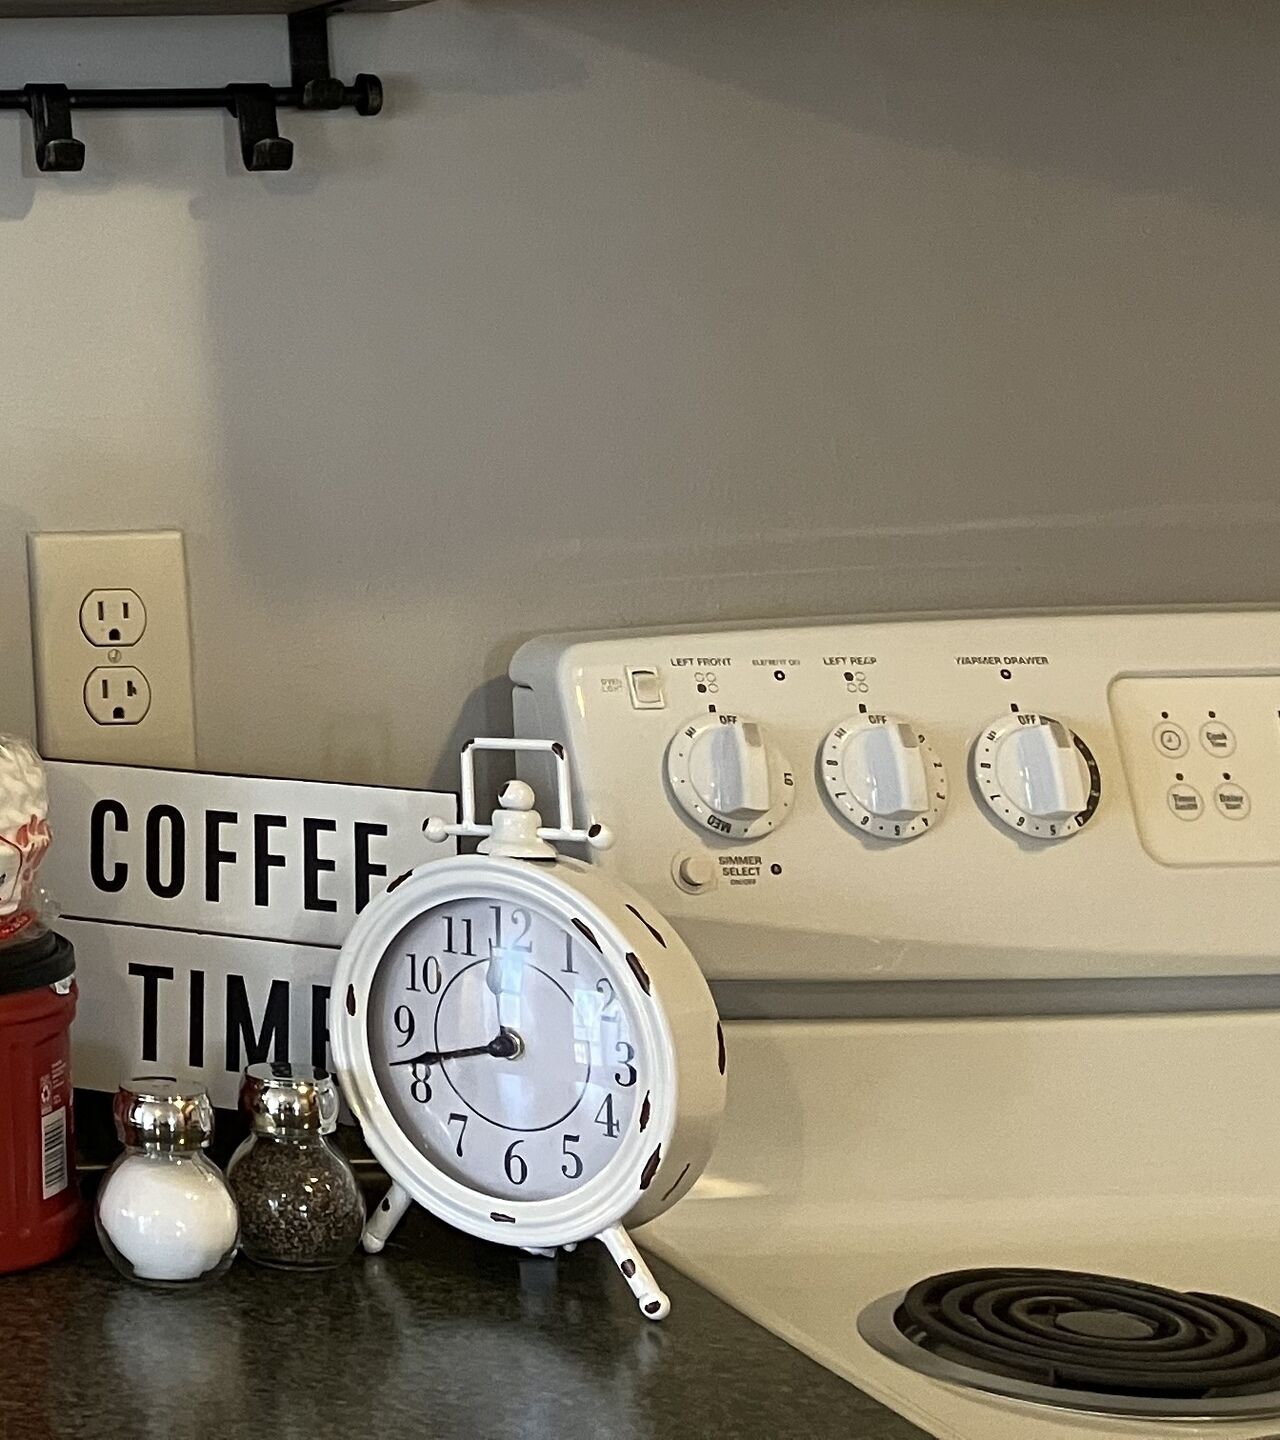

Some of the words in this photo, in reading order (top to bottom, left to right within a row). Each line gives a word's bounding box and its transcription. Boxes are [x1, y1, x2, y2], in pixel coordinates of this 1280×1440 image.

[670, 657, 694, 667] LEFT
[696, 657, 732, 667] FRONT
[823, 656, 848, 667] LEFT
[954, 655, 1002, 666] WARMER
[1003, 655, 1050, 666] DRAWER
[719, 715, 738, 725] OFF
[868, 714, 888, 725] OFF
[1017, 714, 1037, 726] OFF
[834, 727, 848, 740] HI
[707, 814, 733, 834] MED
[860, 814, 870, 826] 6
[1016, 816, 1026, 827] 6
[1049, 824, 1057, 836] 5
[894, 824, 901, 837] 5
[89, 797, 389, 916] COFFEE
[718, 855, 763, 866] SIMMER
[722, 866, 761, 877] SELECT
[441, 915, 477, 958] 11
[489, 904, 534, 953] 12
[560, 929, 579, 975] 1
[405, 953, 442, 995] 10
[595, 977, 621, 1023] 2
[393, 1004, 416, 1048] 9
[614, 1041, 638, 1088] 3
[410, 1063, 433, 1104] 8
[593, 1092, 621, 1140] 4
[446, 1112, 469, 1158] 7
[503, 1139, 529, 1186] 6
[560, 1134, 584, 1180] 5
